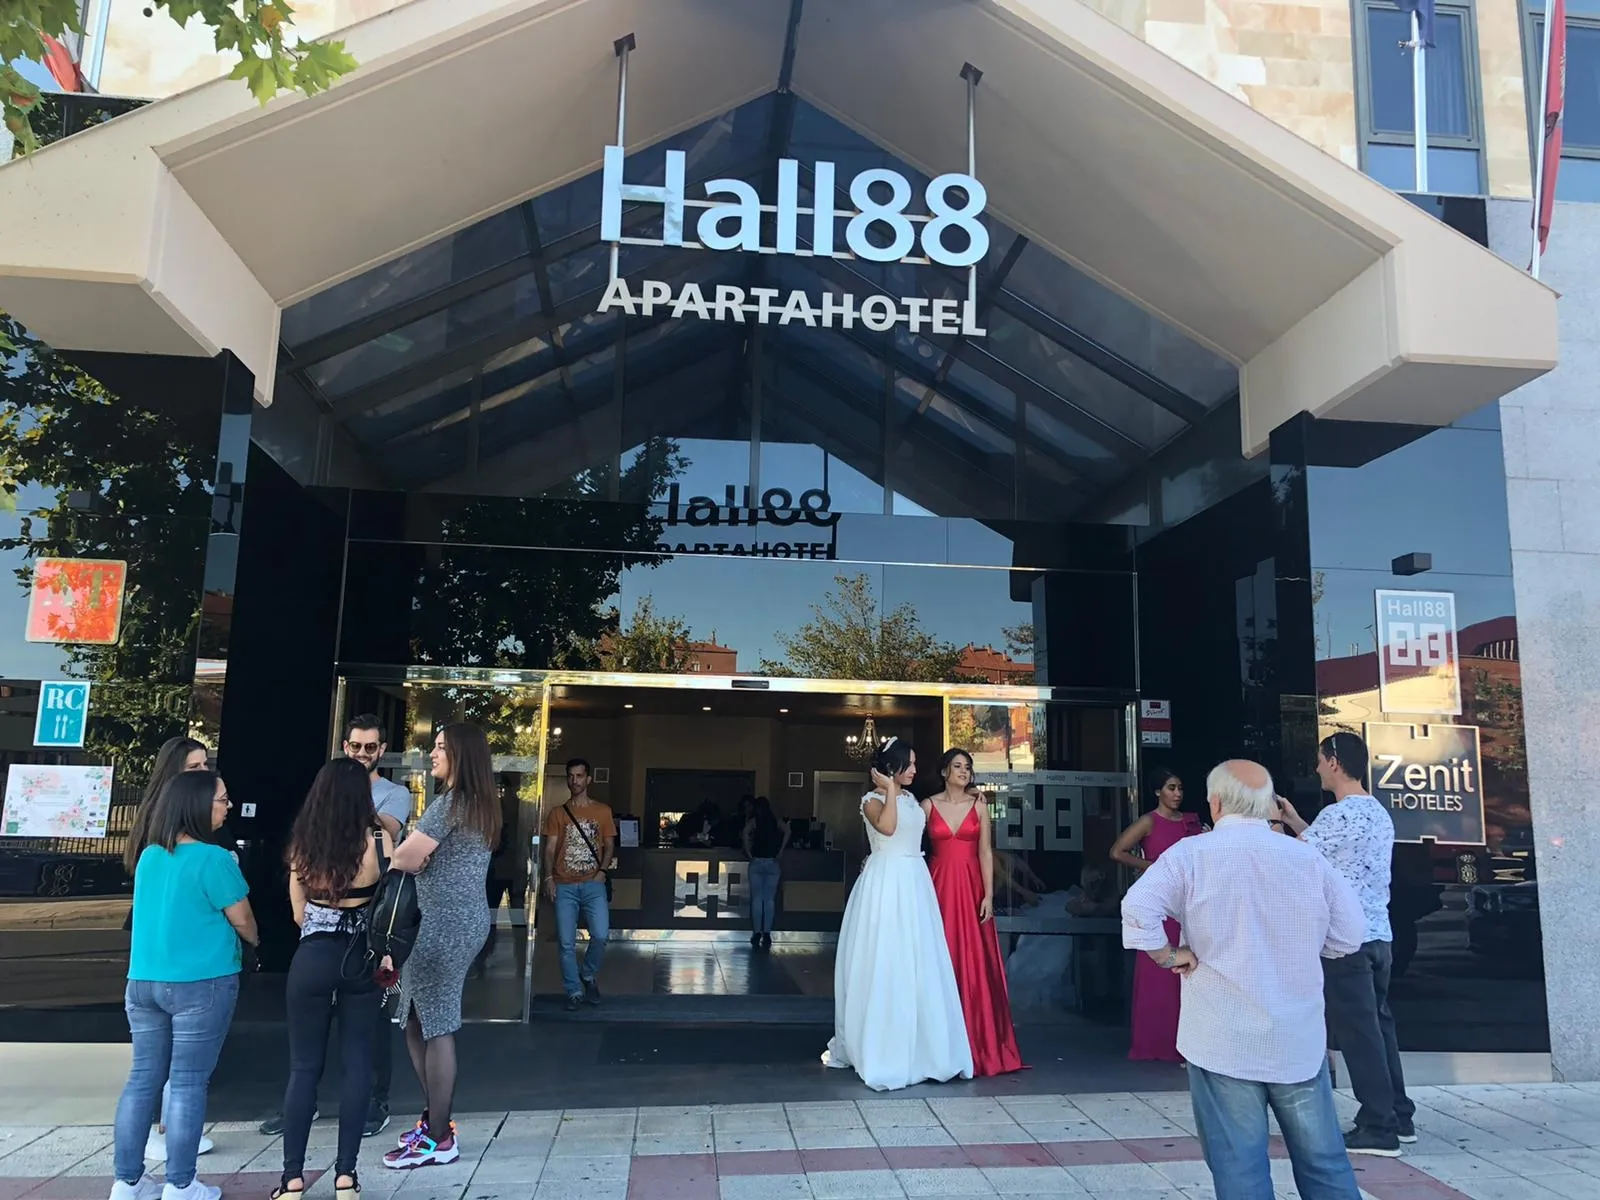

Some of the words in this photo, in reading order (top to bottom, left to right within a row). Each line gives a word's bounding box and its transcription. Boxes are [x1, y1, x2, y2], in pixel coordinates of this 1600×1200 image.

[601, 145, 989, 267] Hall88
[597, 278, 987, 336] APARTAHOTEL
[1387, 600, 1447, 617] Hall88
[46, 687, 84, 710] RC
[1375, 755, 1474, 793] Zenit
[1390, 793, 1463, 812] HOTELES
